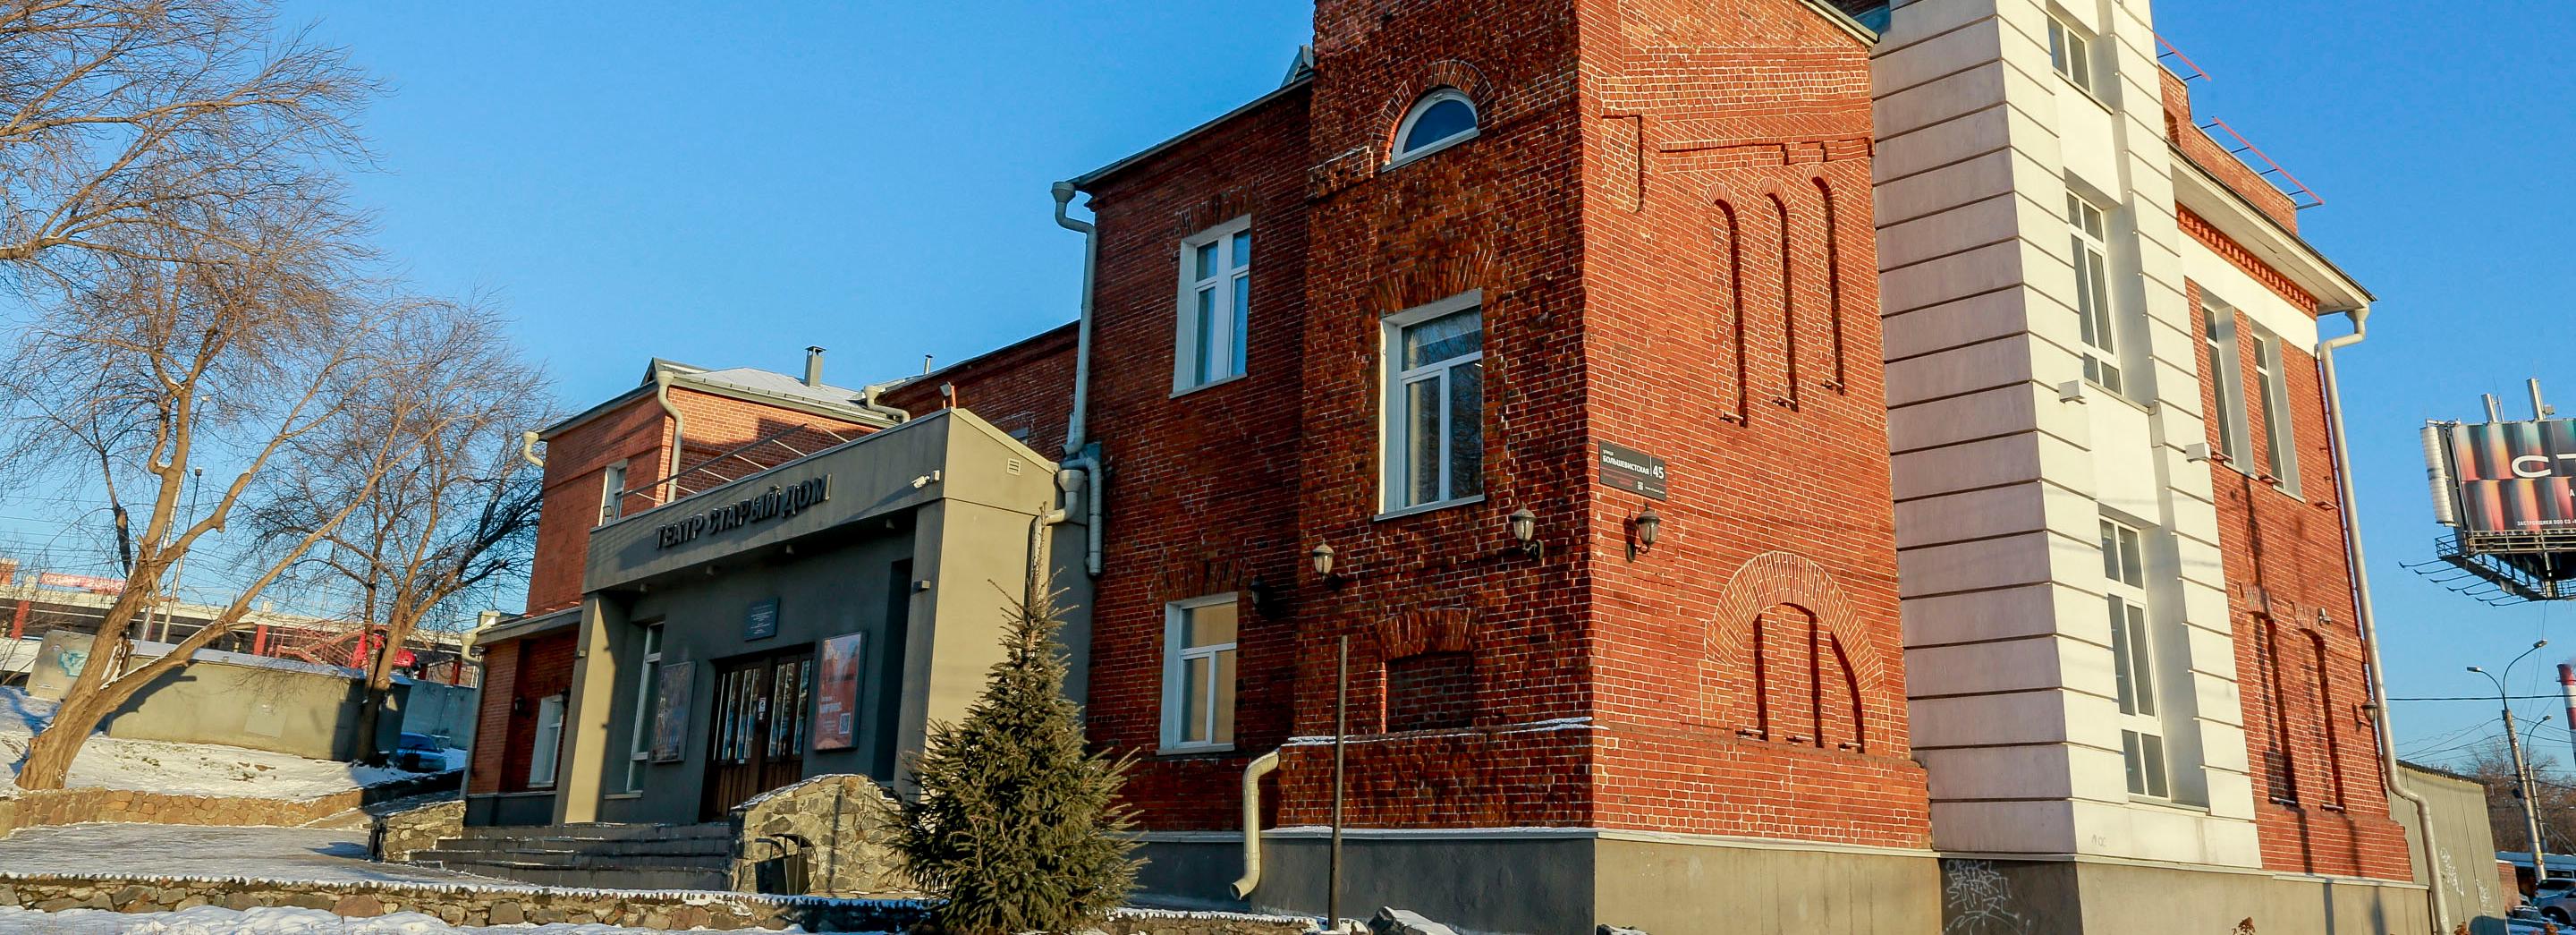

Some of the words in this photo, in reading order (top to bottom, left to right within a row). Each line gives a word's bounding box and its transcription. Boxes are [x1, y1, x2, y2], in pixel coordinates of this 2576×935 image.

[1652, 465, 1664, 479] 45
[656, 513, 705, 549] ТЕАТР
[708, 483, 781, 535] СТАРЫЙ
[781, 472, 833, 518] ДОМ
